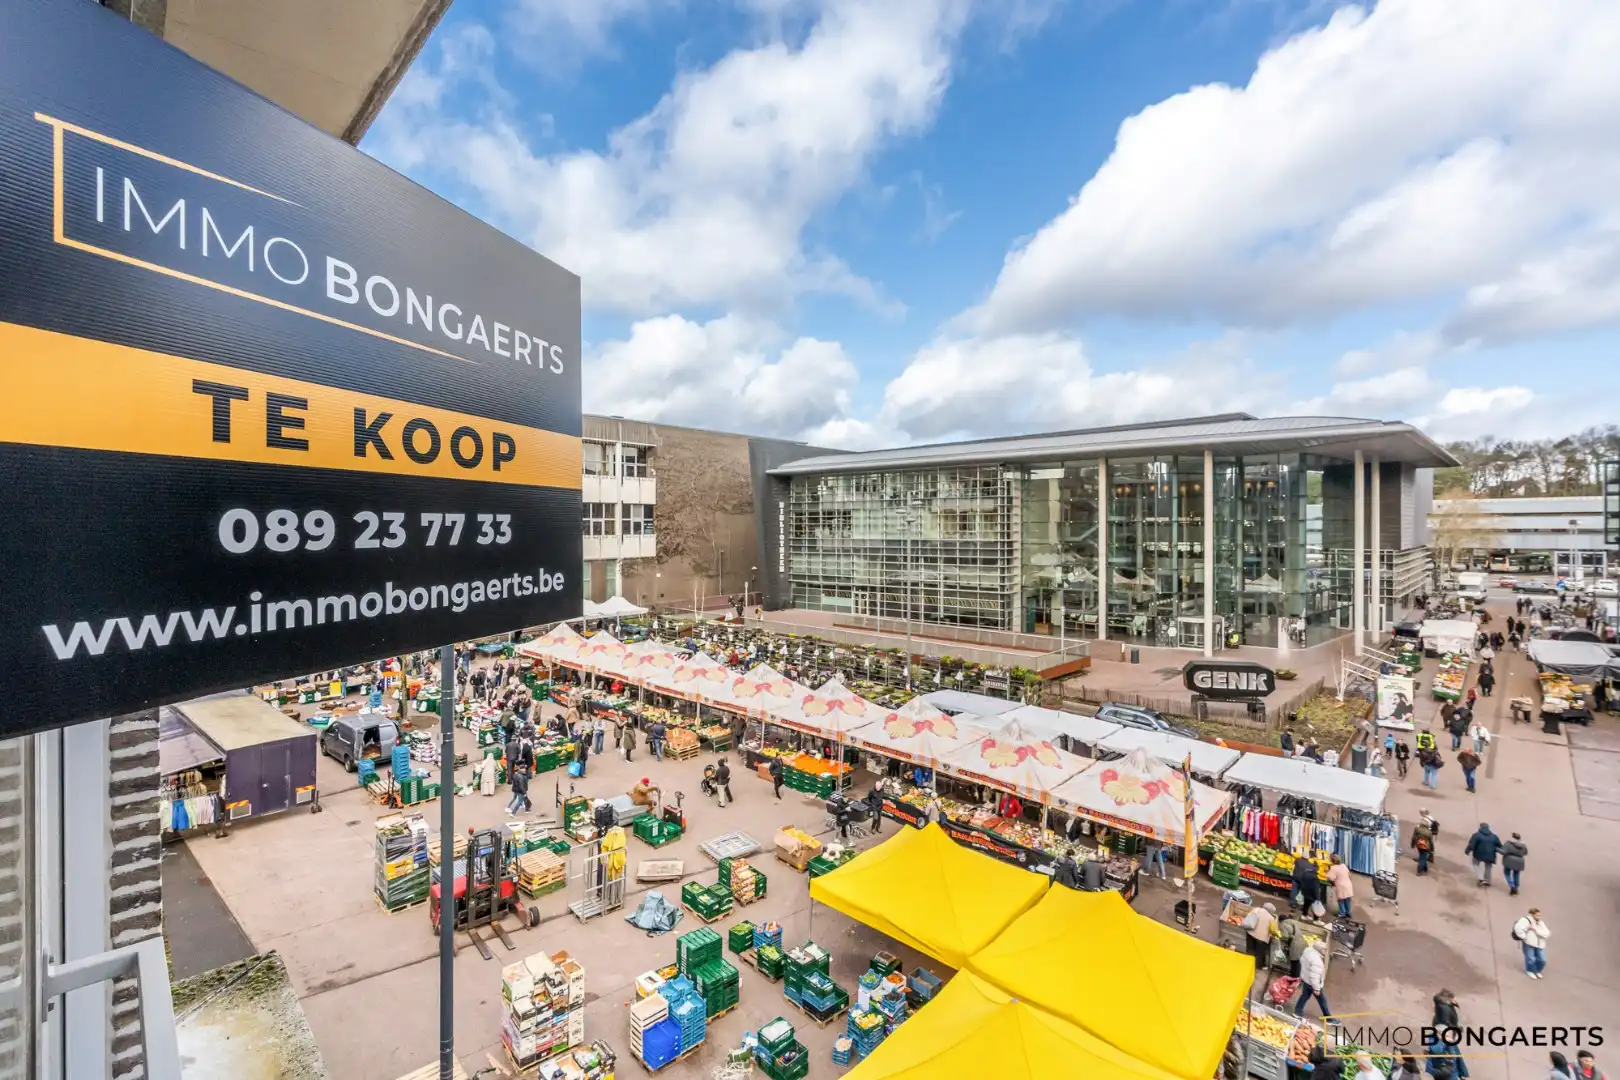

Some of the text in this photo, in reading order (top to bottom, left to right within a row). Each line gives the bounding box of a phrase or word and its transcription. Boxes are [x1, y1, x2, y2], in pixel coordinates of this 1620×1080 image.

[95, 166, 565, 375] IMMO BONGAERTS
[192, 378, 517, 472] TE KOOP
[218, 507, 512, 554] 089 23 77 33
[42, 568, 566, 660] www.immobongaerts.be
[1193, 670, 1268, 691] GENK
